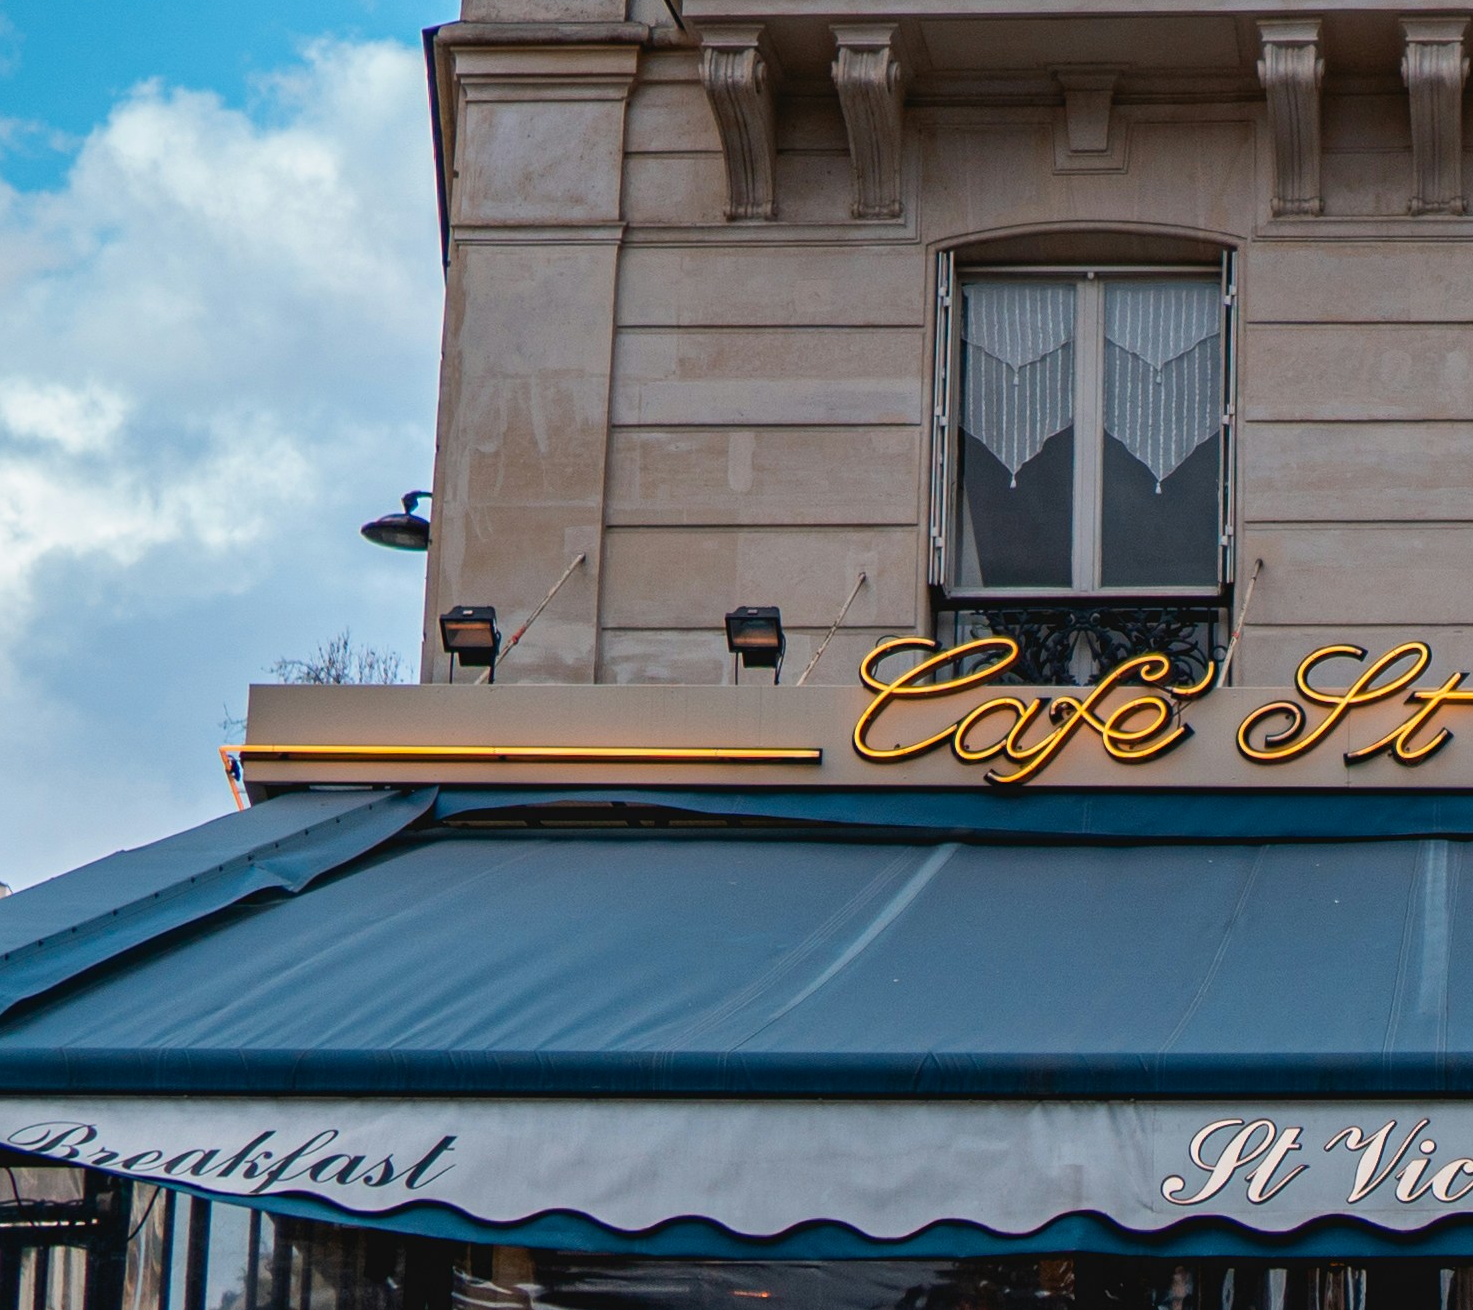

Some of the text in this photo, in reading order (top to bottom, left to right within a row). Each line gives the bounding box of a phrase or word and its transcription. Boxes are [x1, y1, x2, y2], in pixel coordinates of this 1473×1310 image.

[853, 635, 1218, 786] Café
[7, 1121, 457, 1195] Breakfast
[1160, 1118, 1310, 1205] St
